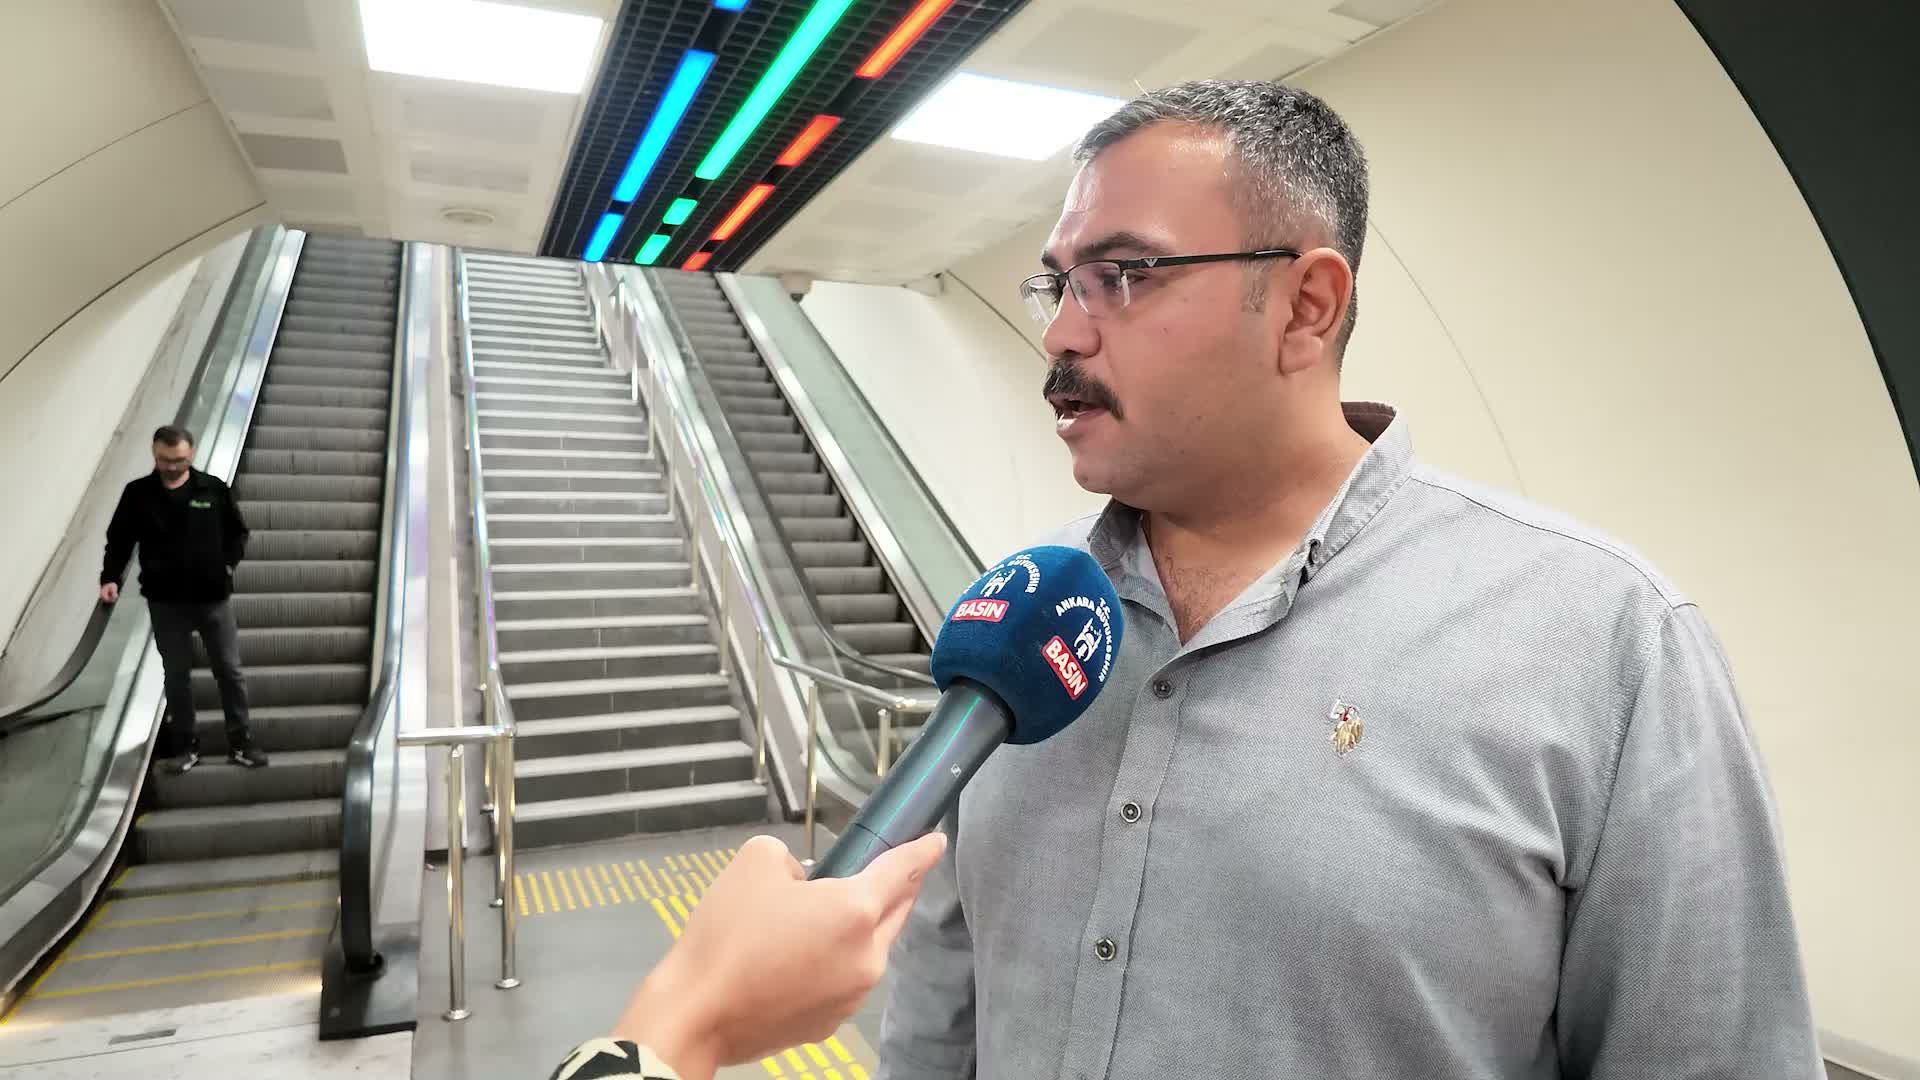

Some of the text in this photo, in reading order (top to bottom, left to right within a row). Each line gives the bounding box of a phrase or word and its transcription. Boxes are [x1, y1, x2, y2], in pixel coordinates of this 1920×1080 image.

[955, 601, 1005, 618] BASIN
[1055, 596, 1095, 617] ANKARA
[1045, 639, 1086, 696] BASIN
